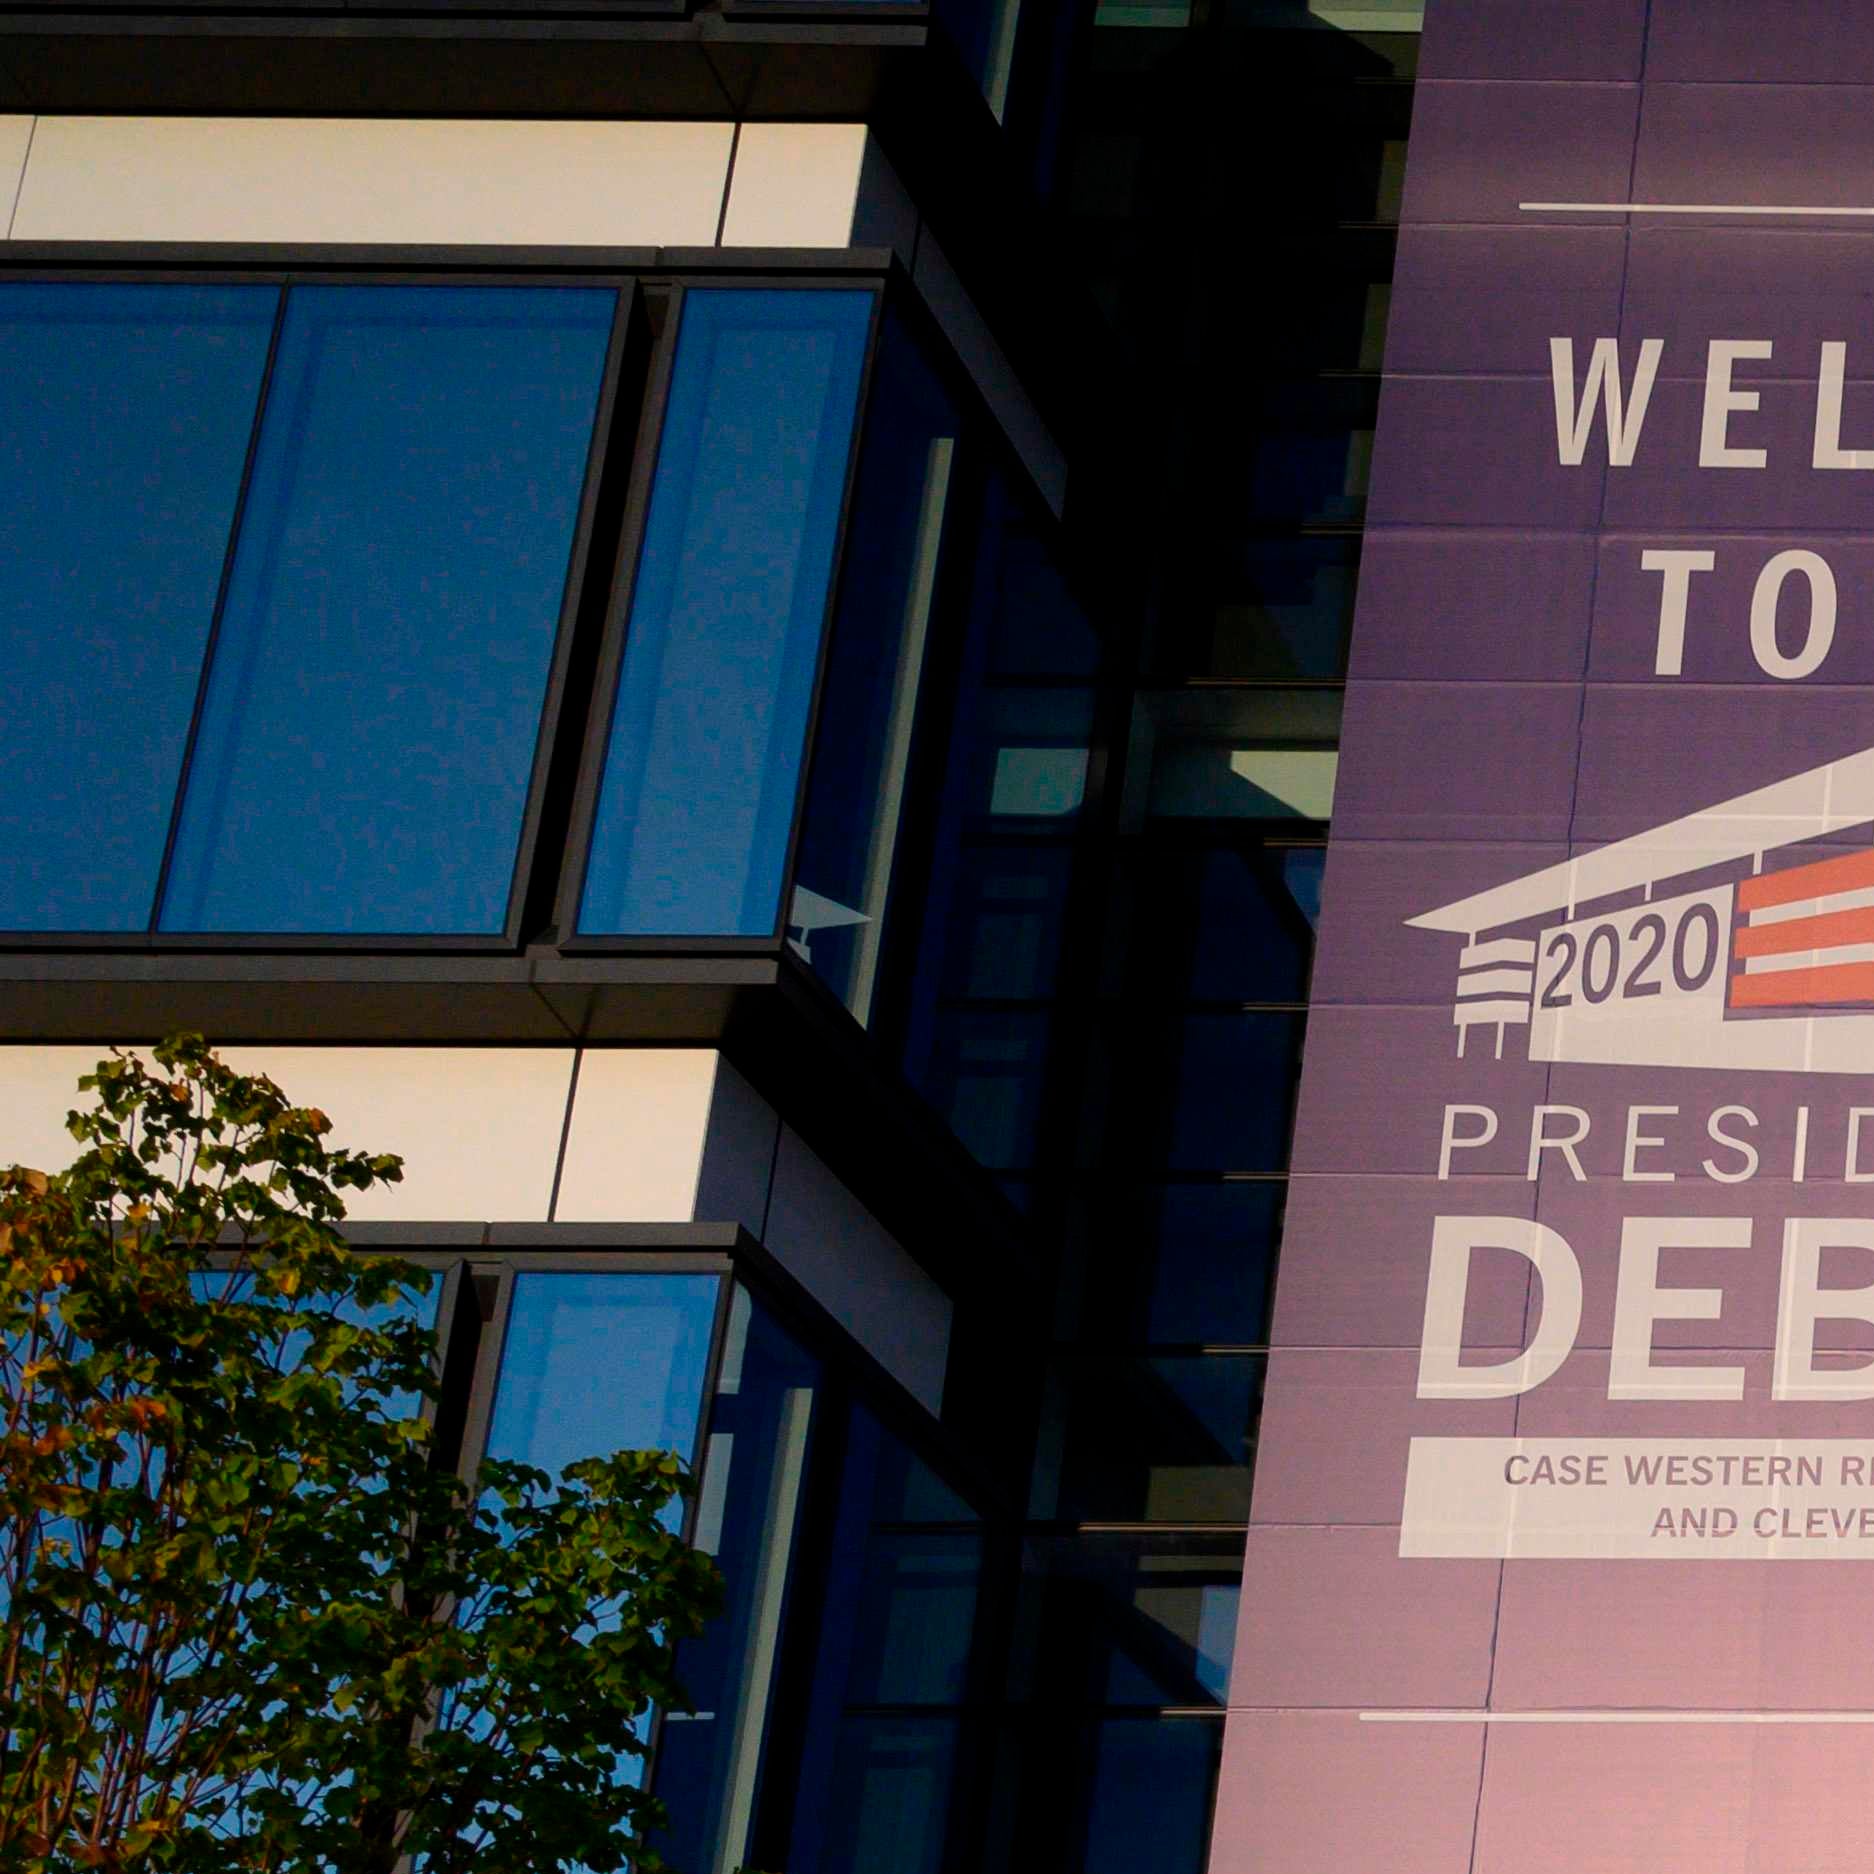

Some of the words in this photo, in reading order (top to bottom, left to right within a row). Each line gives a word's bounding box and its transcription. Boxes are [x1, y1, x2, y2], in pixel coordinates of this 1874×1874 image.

[1641, 550, 1838, 680] TO
[1541, 903, 1719, 1009] 2020
[1504, 1454, 1608, 1486] CASE
[1623, 1455, 1822, 1487] WESTERN
[1651, 1506, 1738, 1538] AND
